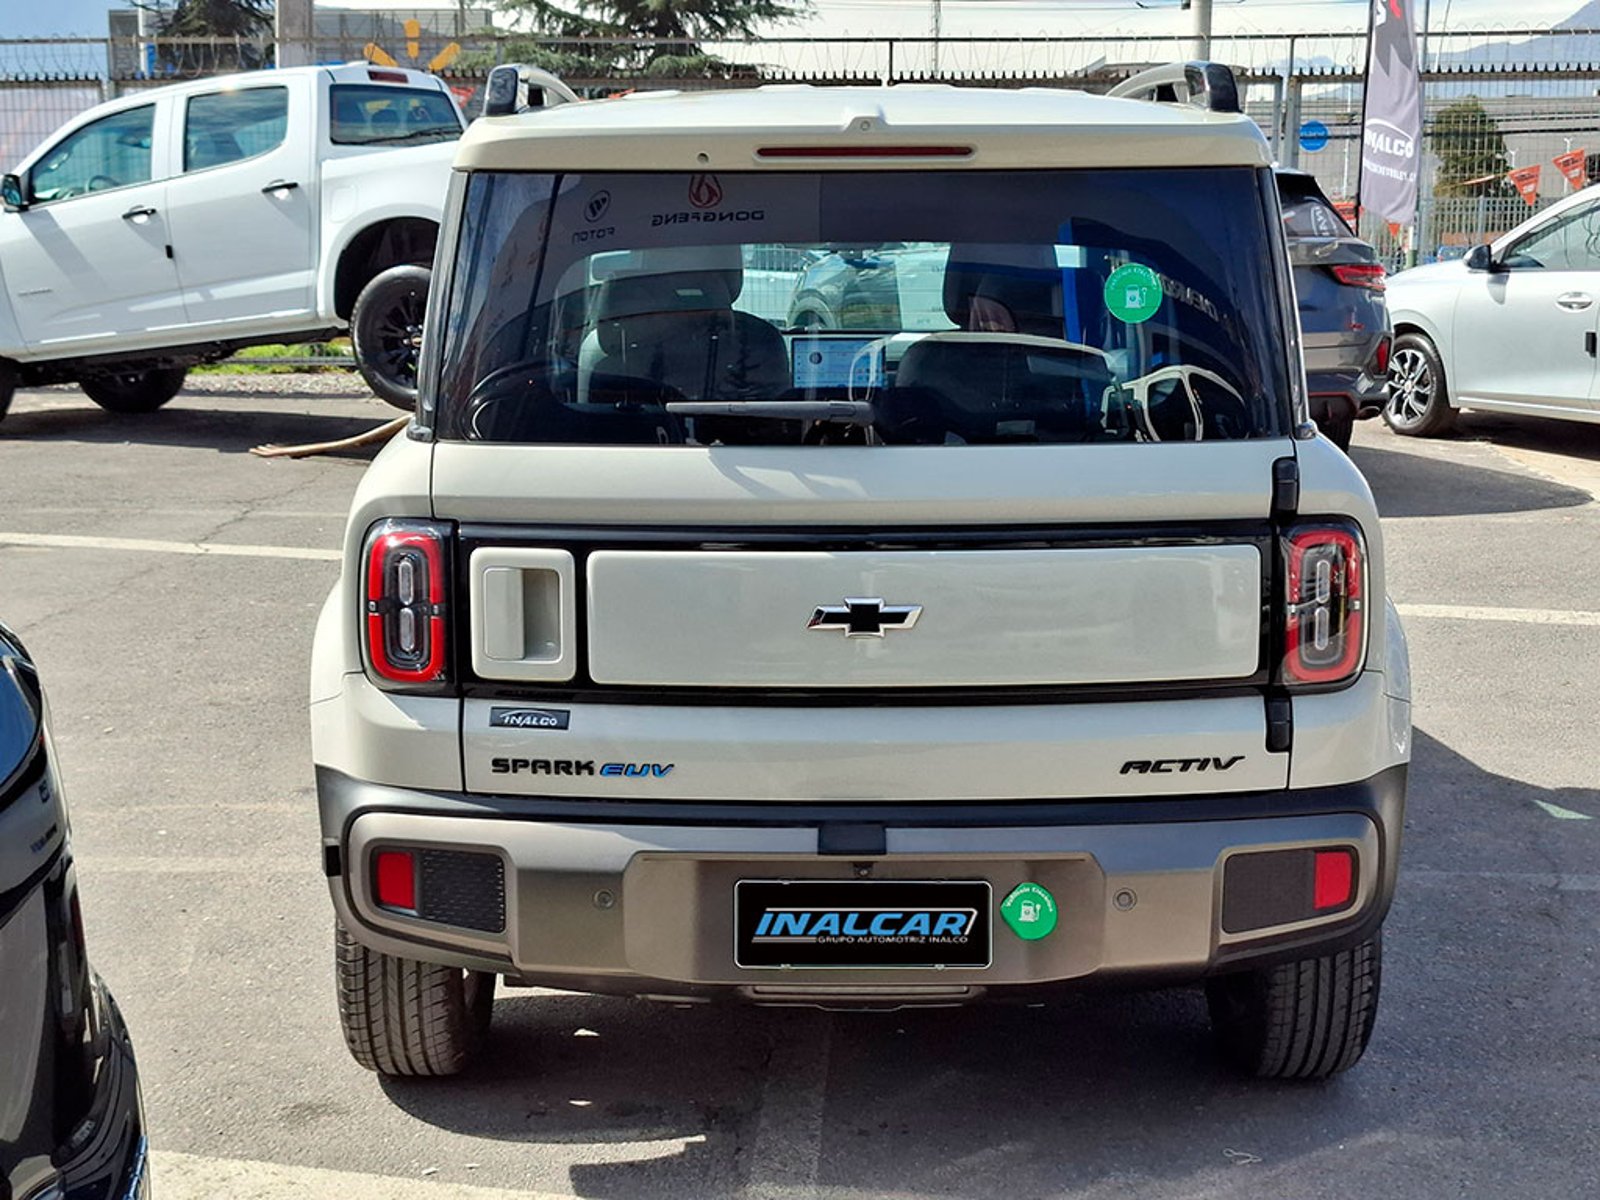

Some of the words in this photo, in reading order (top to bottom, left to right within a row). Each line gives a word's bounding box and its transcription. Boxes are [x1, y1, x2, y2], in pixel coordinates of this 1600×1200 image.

[502, 714, 558, 727] INALCO
[491, 758, 595, 776] SPARK
[600, 763, 675, 778] EUV
[1119, 756, 1246, 774] ACTIV
[755, 913, 968, 936] INALCAR
[818, 936, 855, 944] GRUPO
[857, 936, 926, 944] AUTOMOTRIZ
[929, 936, 969, 944] INALCO
